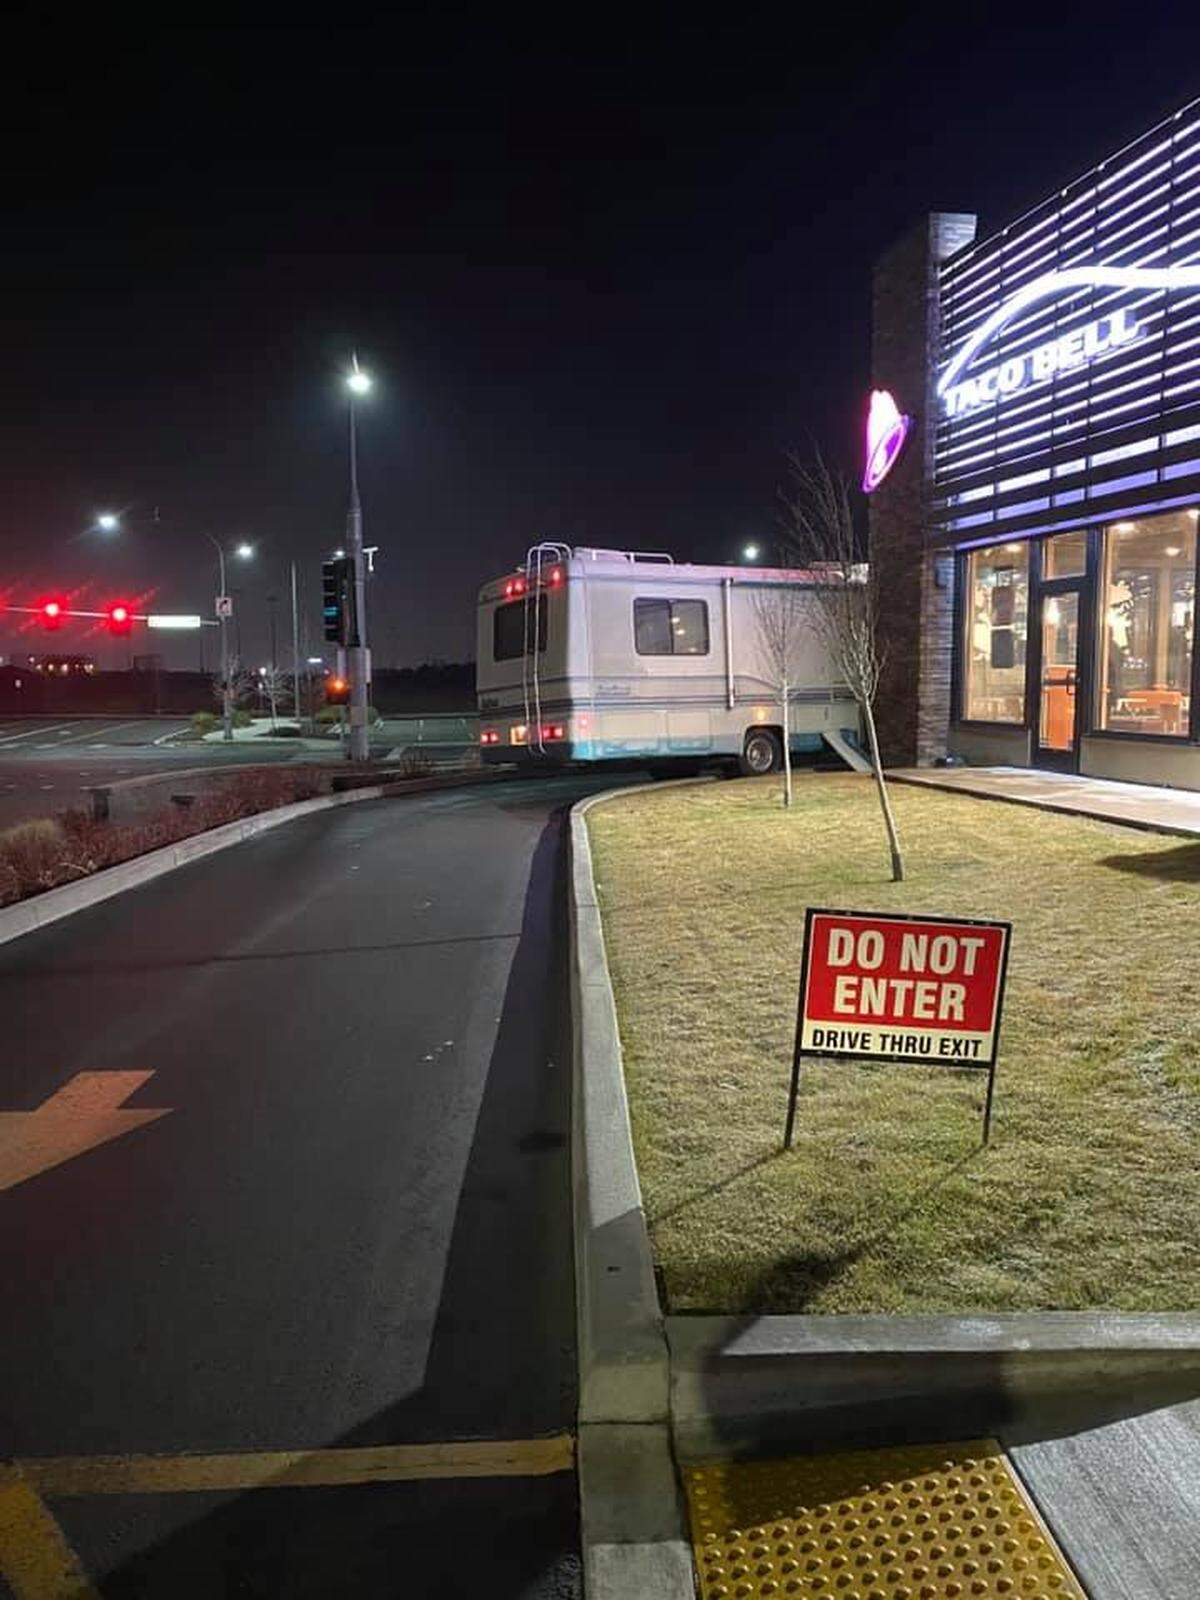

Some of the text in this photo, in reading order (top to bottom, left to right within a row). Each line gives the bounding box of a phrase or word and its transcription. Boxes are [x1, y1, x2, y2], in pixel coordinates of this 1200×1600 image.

[943, 308, 1143, 416] TACO BELL
[827, 928, 985, 976] DO NOT
[833, 975, 966, 1021] ENTER
[812, 1029, 982, 1058] DRIVE THRU EXIT
